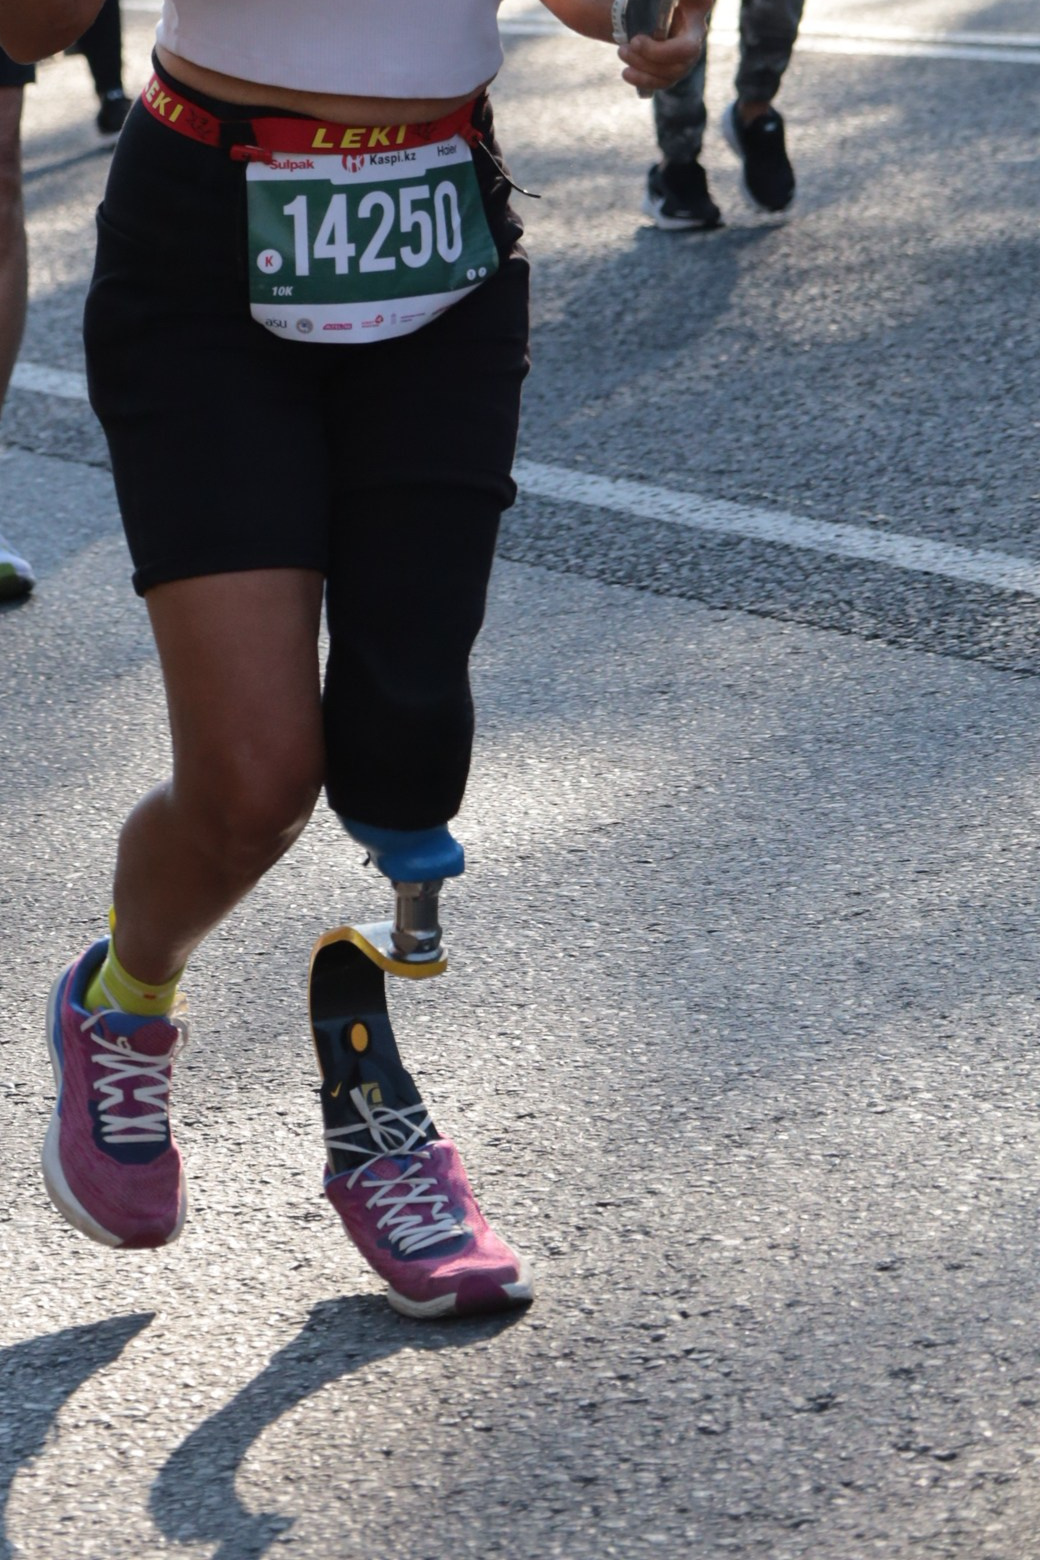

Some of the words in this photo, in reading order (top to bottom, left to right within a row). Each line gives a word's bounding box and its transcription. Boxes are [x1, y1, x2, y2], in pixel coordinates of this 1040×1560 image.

[144, 79, 184, 123] EKI
[311, 124, 407, 149] LEKI
[269, 158, 315, 173] Sulpak
[369, 151, 416, 166] Kaspi.kz
[283, 180, 463, 277] 14250
[271, 285, 293, 297] 10K
